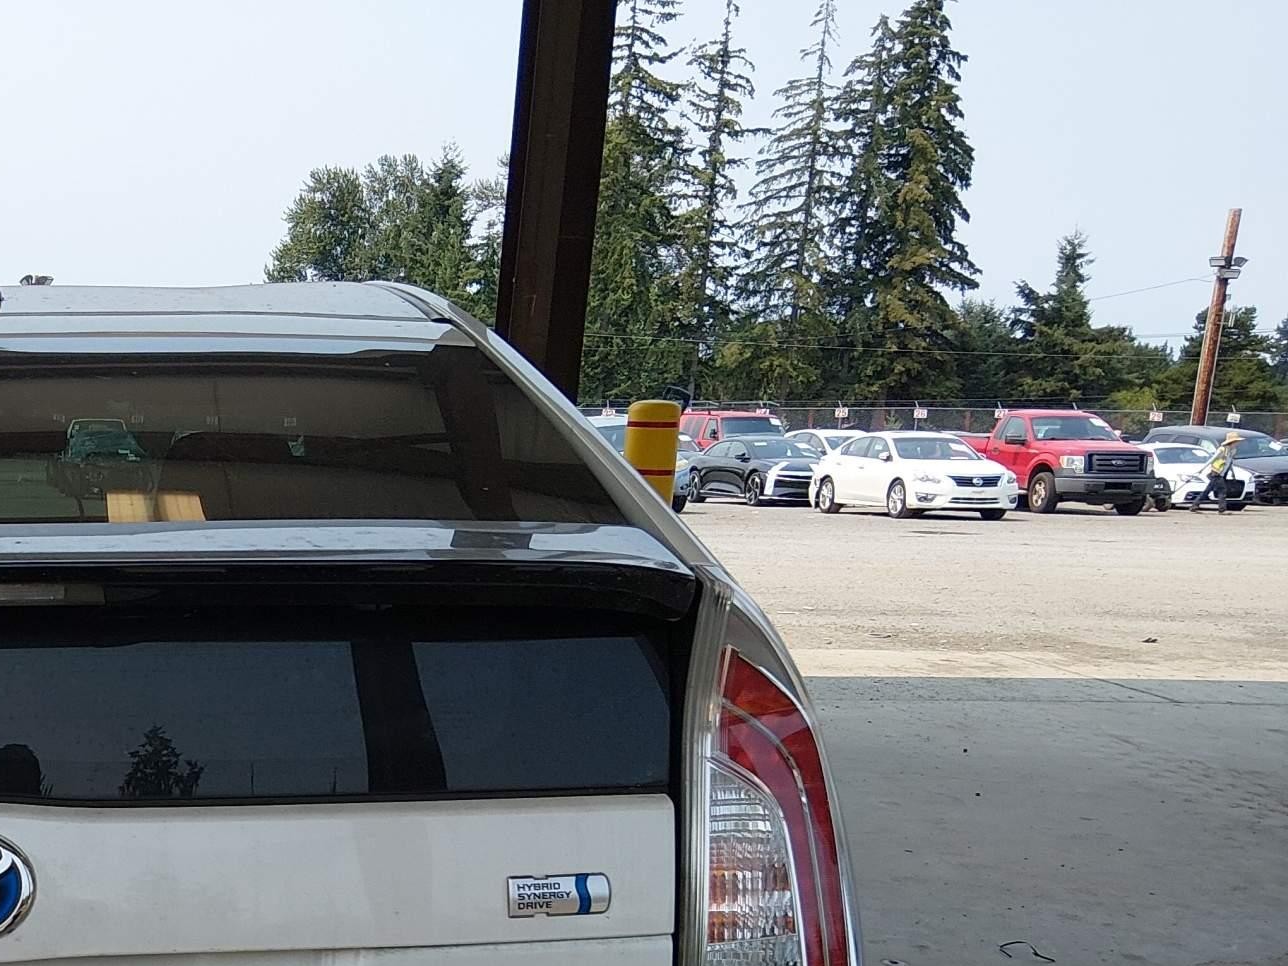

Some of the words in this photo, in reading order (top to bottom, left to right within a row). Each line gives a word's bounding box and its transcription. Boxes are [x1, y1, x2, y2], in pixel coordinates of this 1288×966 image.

[516, 882, 561, 892] HYBRID
[517, 891, 572, 901] SYNERGY
[518, 900, 553, 910] DRIVE
